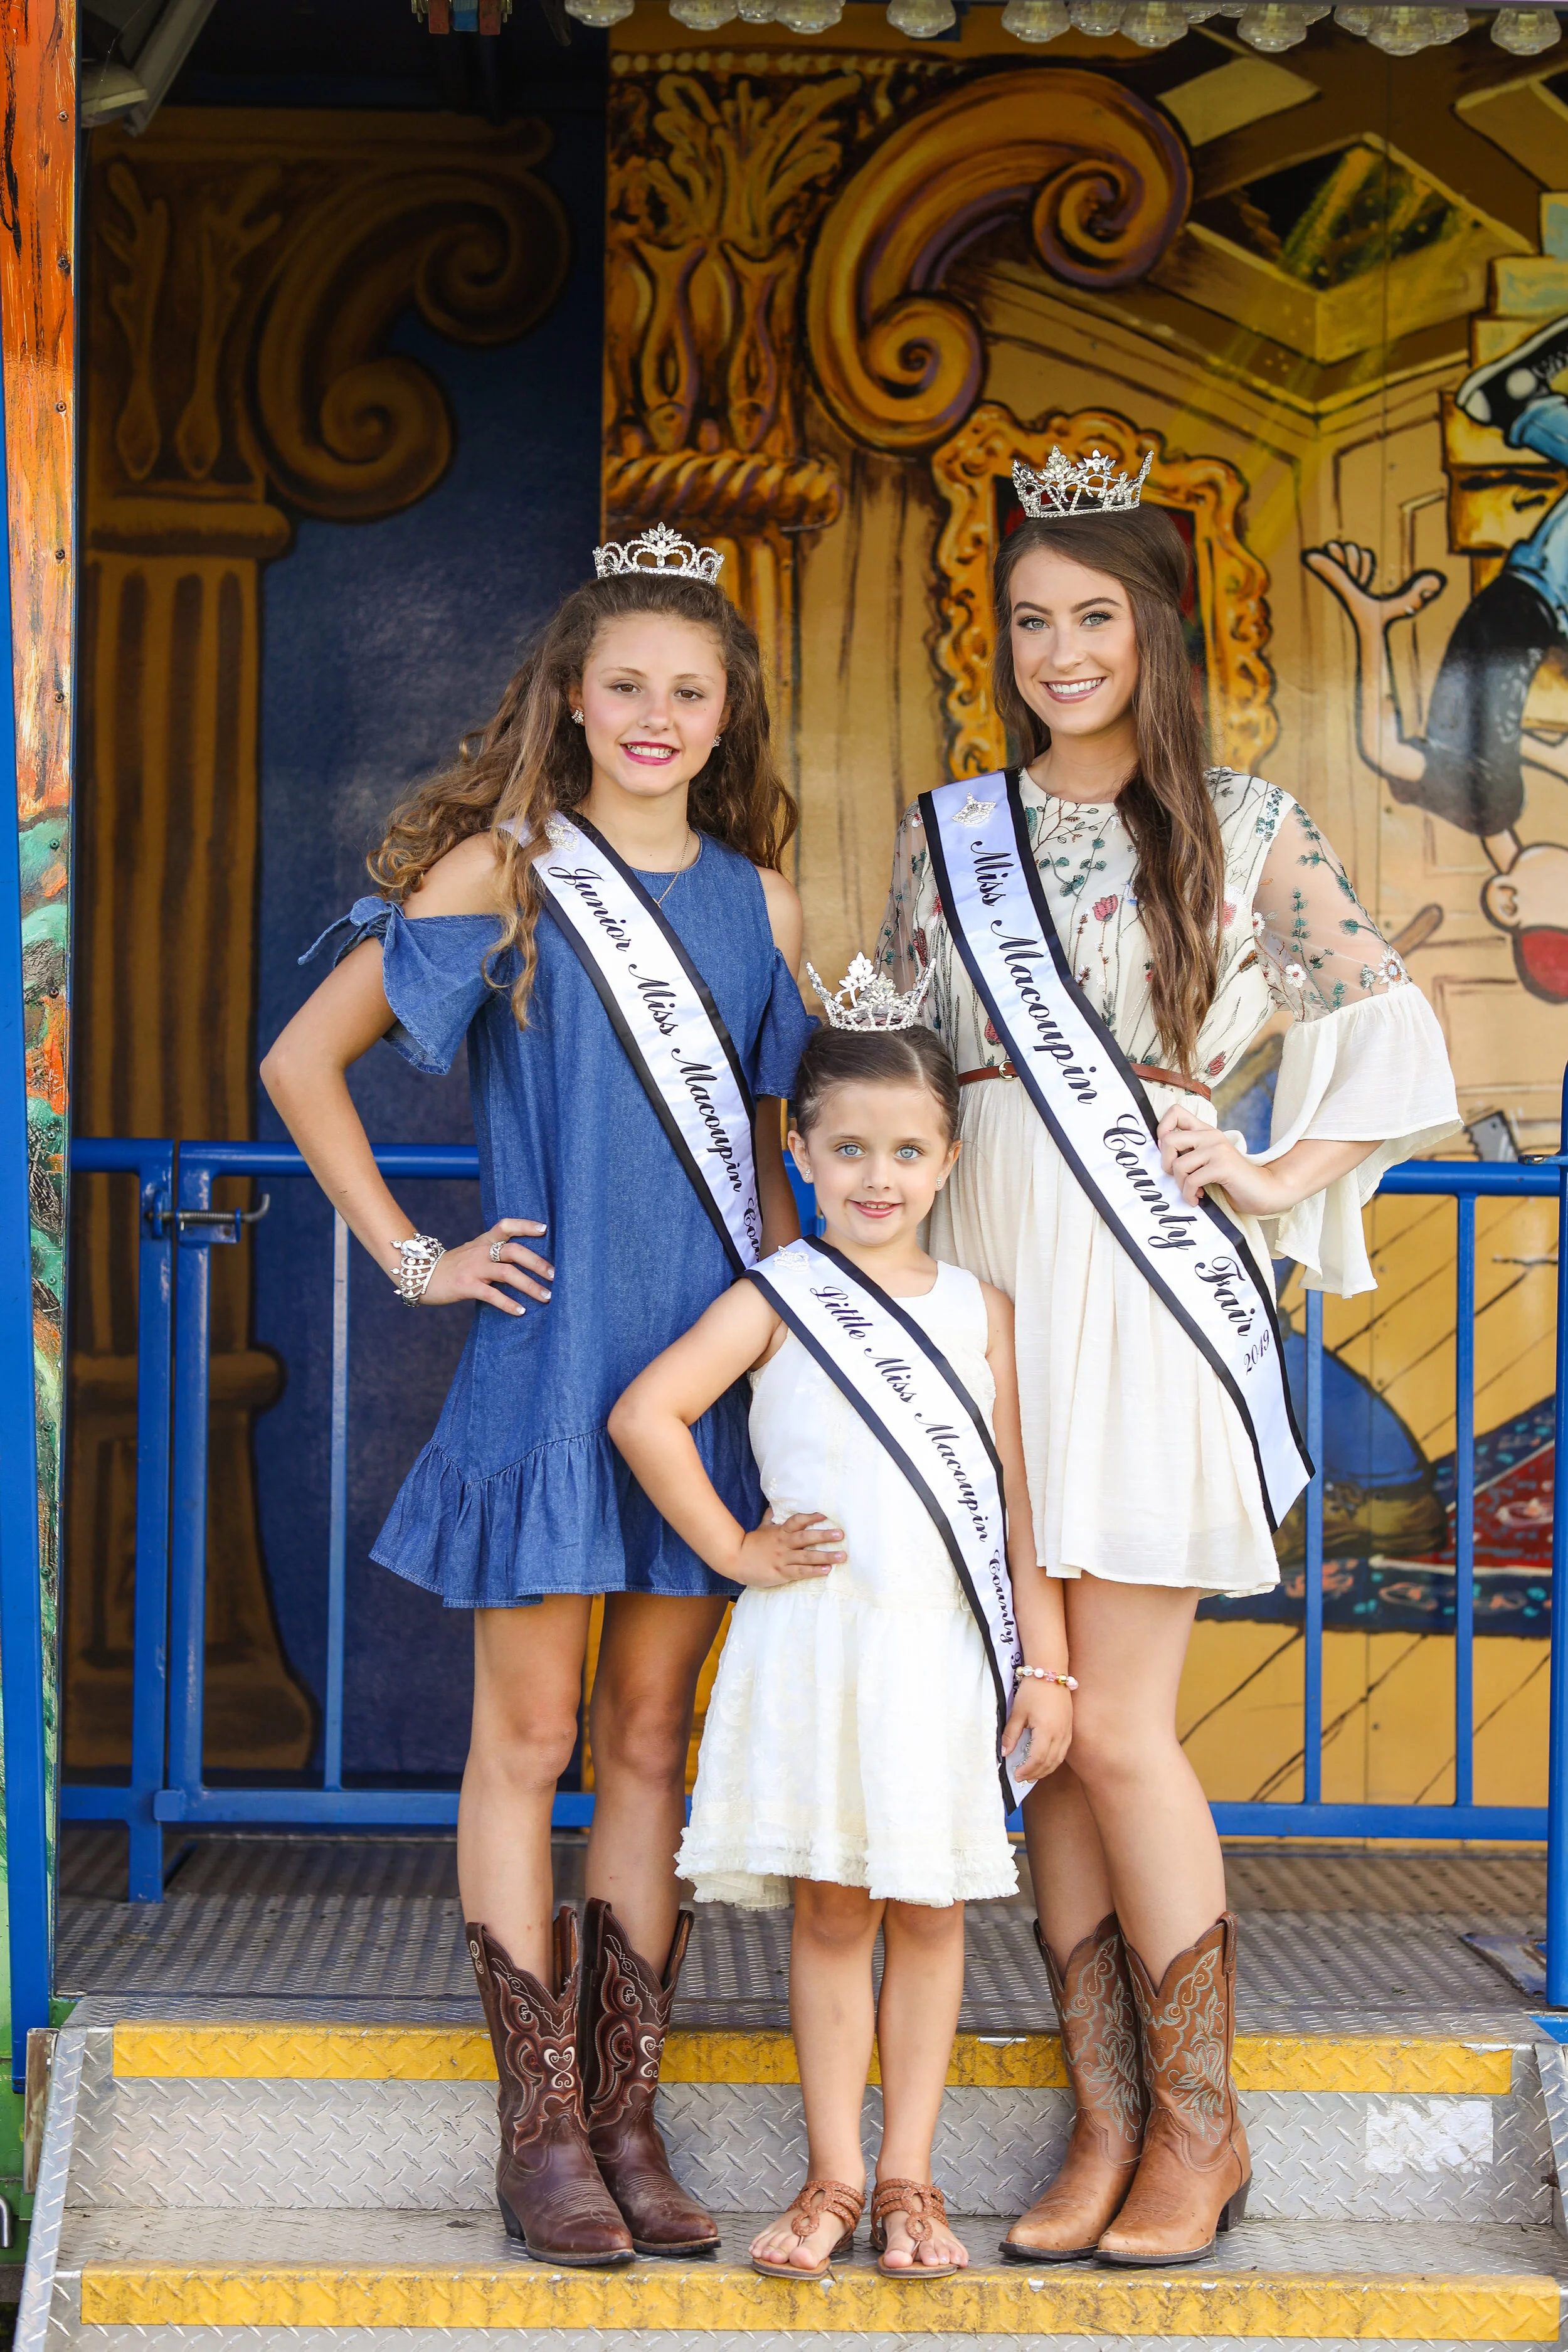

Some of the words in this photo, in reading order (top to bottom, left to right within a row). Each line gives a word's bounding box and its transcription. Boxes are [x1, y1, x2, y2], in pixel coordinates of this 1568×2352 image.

[971, 841, 1020, 906] Miss
[548, 867, 631, 951] Junior
[628, 964, 678, 1036] Miss
[672, 1049, 742, 1192] Macoupin
[991, 920, 1097, 1104] Macoupin
[1103, 1114, 1197, 1249] County
[1194, 1257, 1255, 1336] Fair
[1244, 1330, 1269, 1375] 2019
[810, 1286, 873, 1340] Little
[865, 1348, 916, 1403] Miss
[915, 1413, 988, 1542] Macoupin
[989, 1549, 1014, 1645] County
